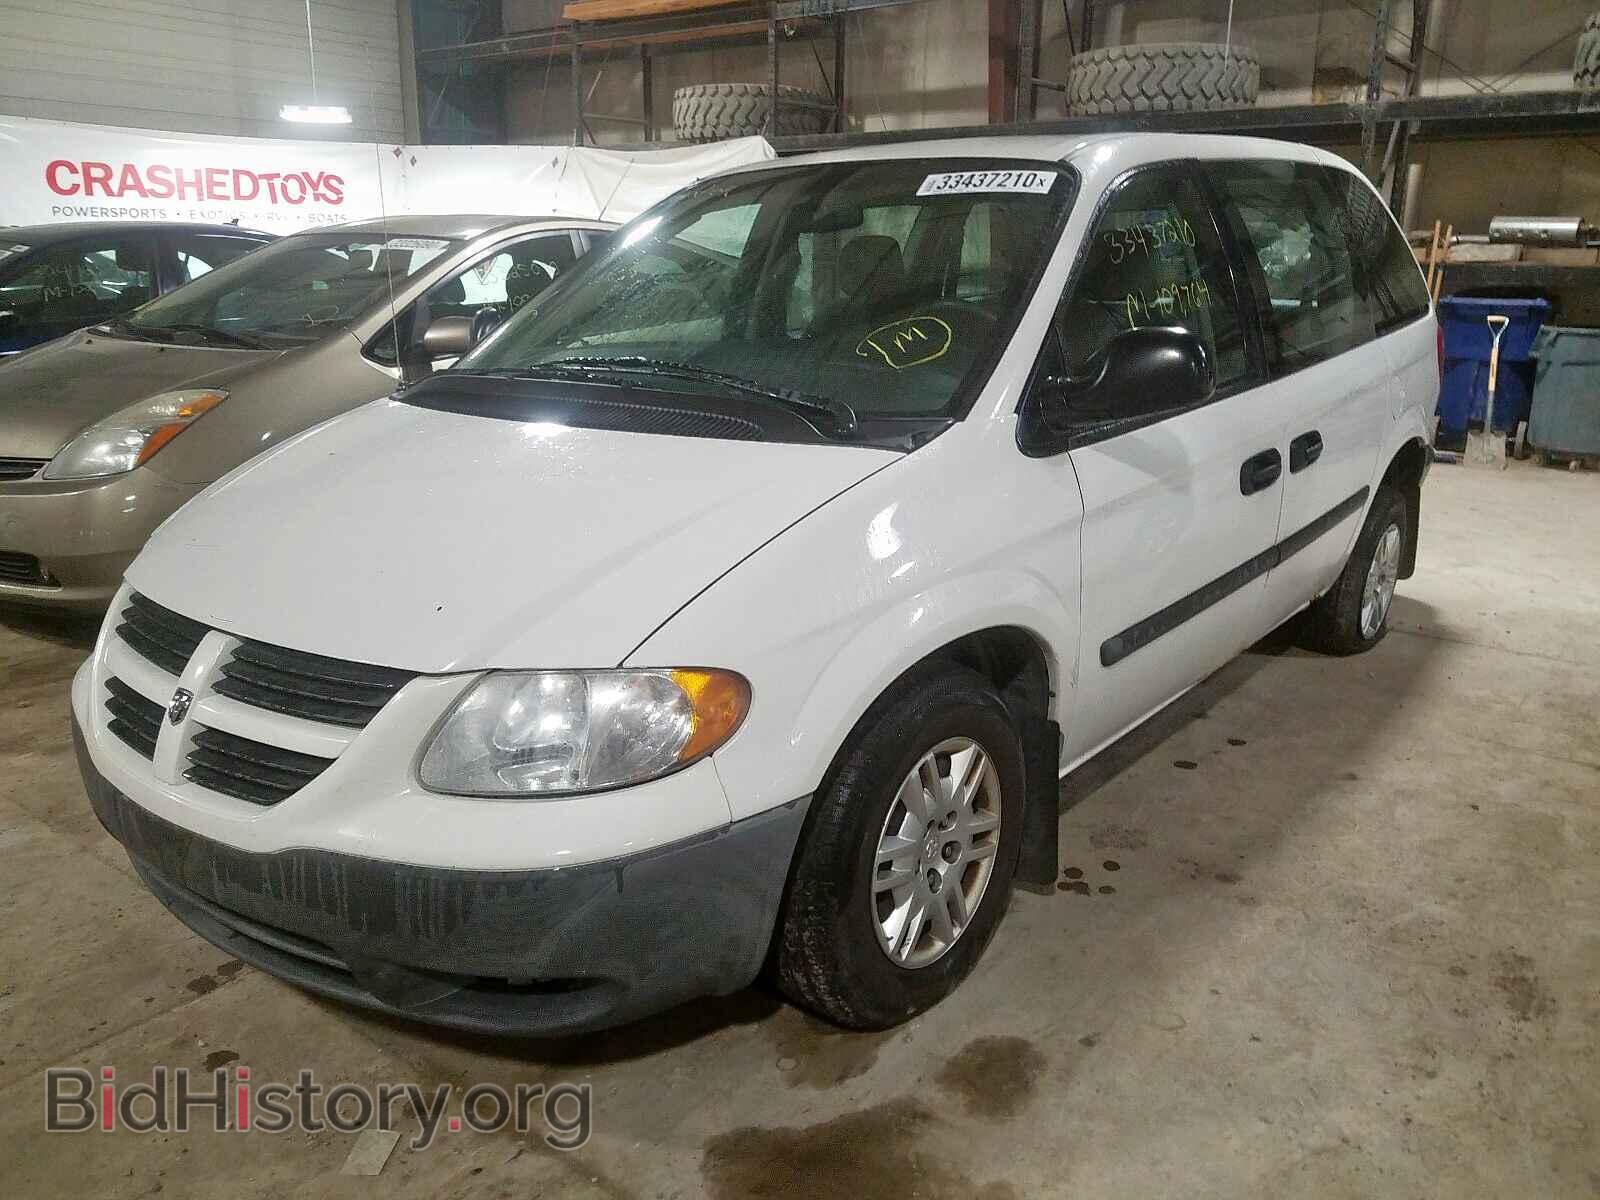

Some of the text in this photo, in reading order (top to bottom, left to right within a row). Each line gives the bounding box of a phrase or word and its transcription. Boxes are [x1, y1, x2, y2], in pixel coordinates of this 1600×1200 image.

[45, 159, 346, 206] CRASHEDTOYS
[936, 172, 1038, 190] 33437210
[51, 205, 168, 219] POWERSPORTS
